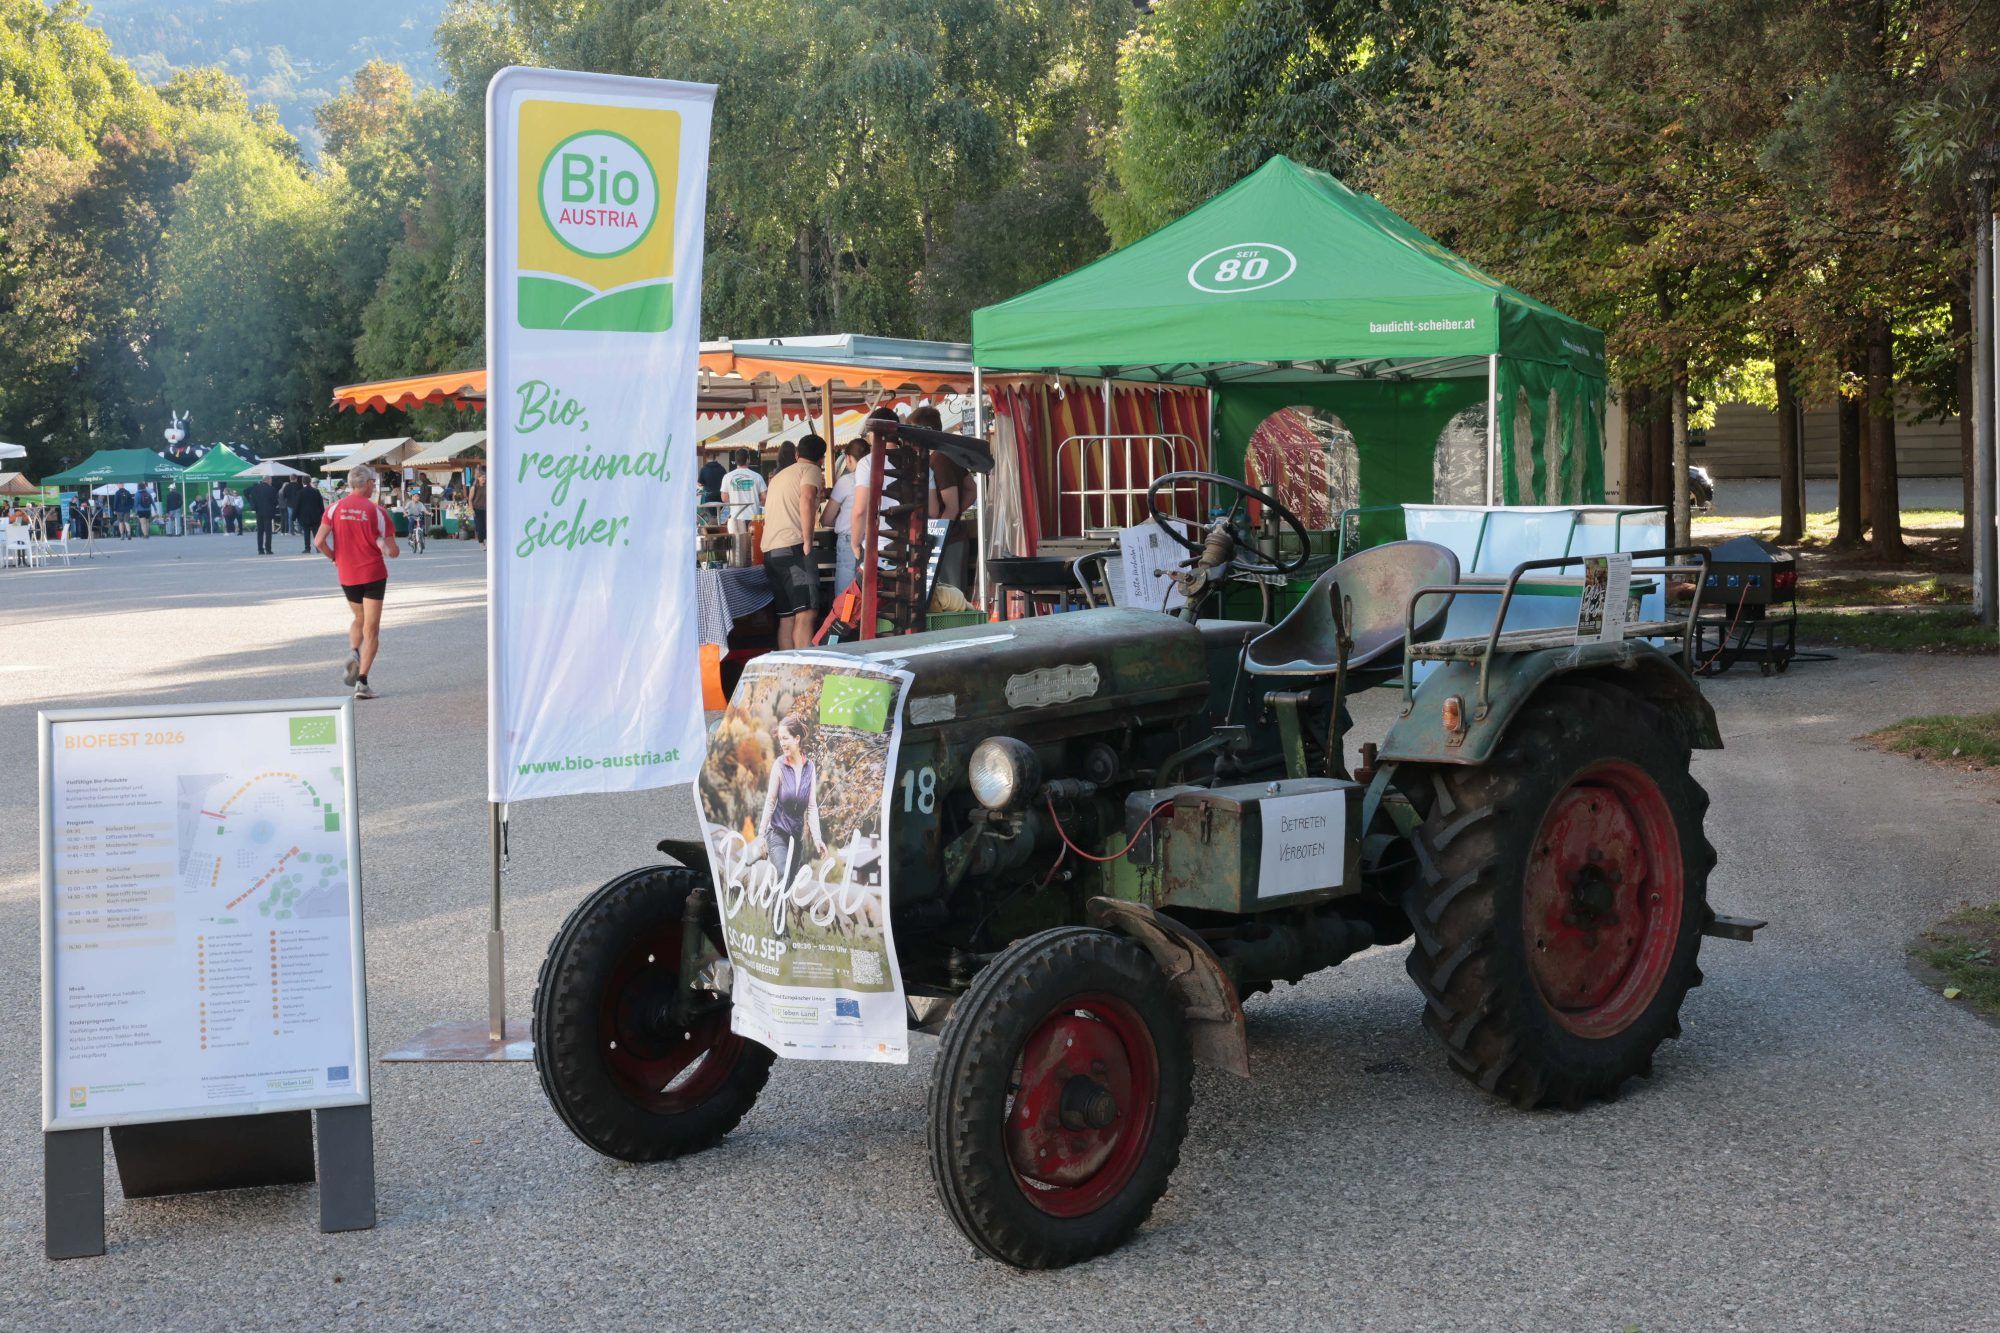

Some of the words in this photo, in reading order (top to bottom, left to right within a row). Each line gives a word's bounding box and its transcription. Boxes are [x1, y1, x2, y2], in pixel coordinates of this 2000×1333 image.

[562, 153, 639, 206] Bio
[559, 208, 639, 229] AUSTRIA
[1235, 250, 1260, 259] SEIT
[1214, 257, 1270, 283] 80
[1369, 317, 1476, 334] baudicht-scheiber.at
[514, 379, 590, 434] Bio,
[517, 433, 672, 506] regional,
[515, 498, 630, 559] sicher.
[64, 732, 141, 749] BIOFEST
[144, 730, 185, 746] 2026
[516, 747, 680, 776] www.bio-austria.at
[901, 765, 937, 815] 18
[1281, 815, 1327, 833] BETRETEN
[1279, 842, 1326, 862] VERBOTEN
[740, 932, 758, 956] 20.
[760, 936, 787, 962] SEP
[792, 941, 812, 951] 09:30
[836, 944, 848, 954] Uhr
[755, 962, 780, 976] BREGENZ
